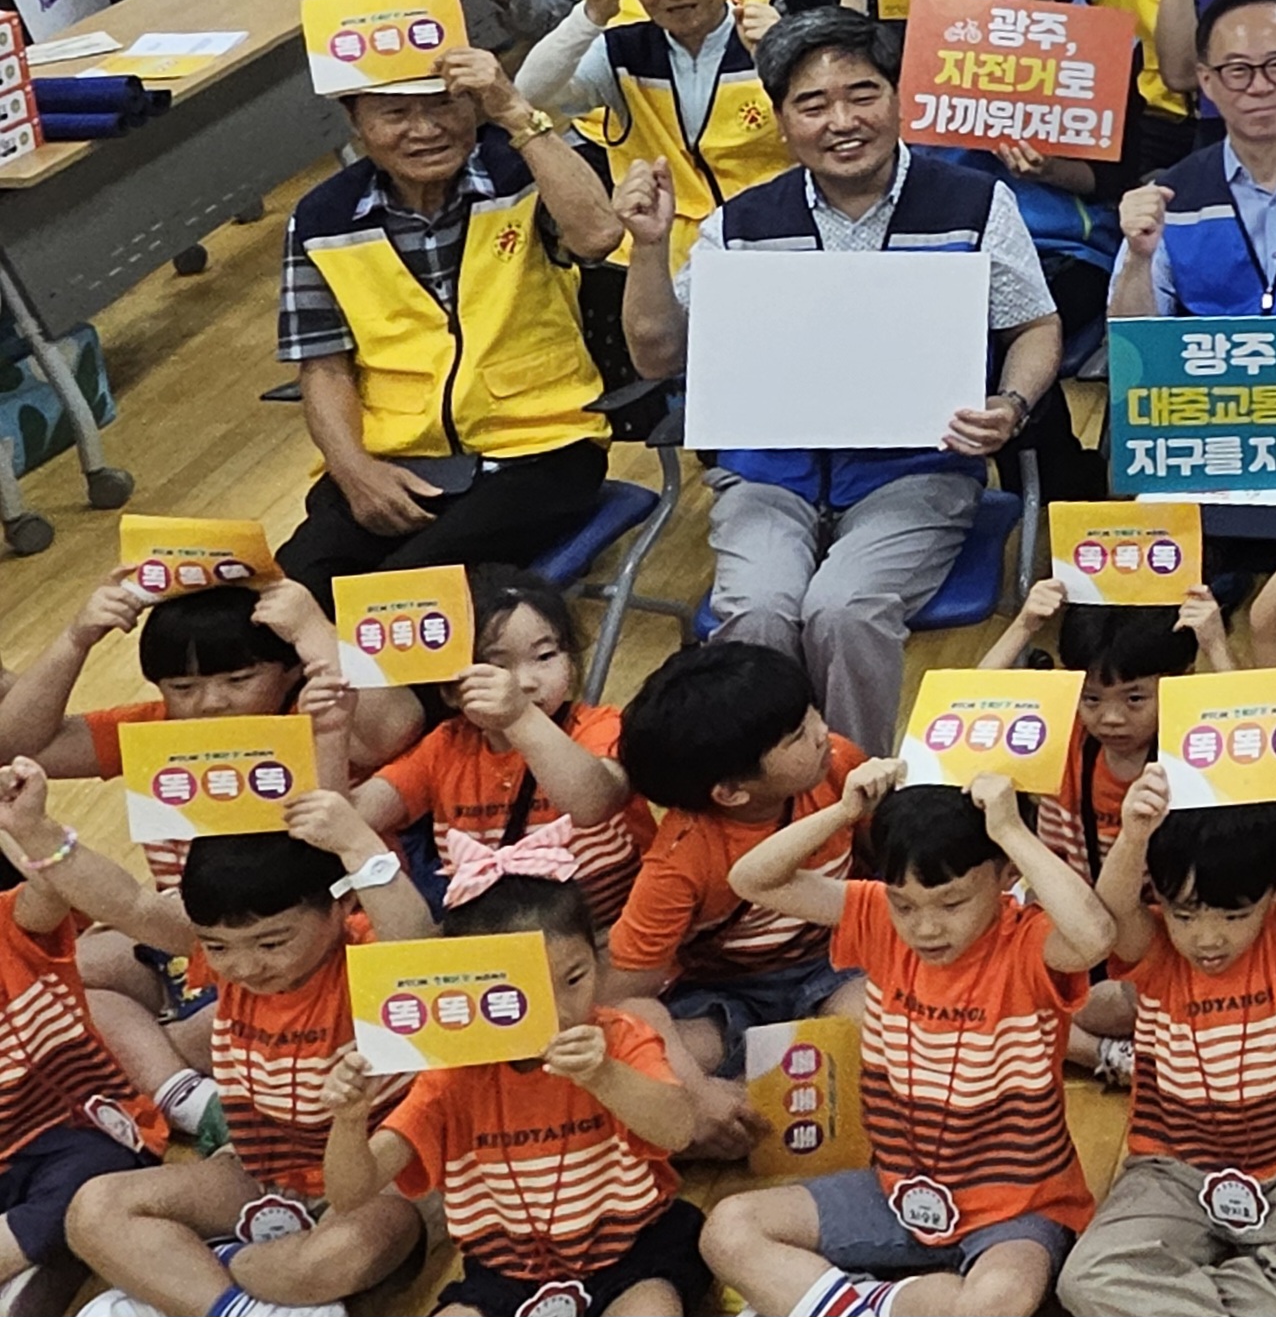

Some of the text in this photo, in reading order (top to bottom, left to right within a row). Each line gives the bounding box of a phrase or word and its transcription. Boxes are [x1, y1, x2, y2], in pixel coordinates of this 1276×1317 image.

[988, 7, 1077, 59] 광주,
[933, 50, 1096, 101] 자전거로
[910, 95, 1114, 149] 가까워져요!
[1127, 435, 1244, 477] 지구를
